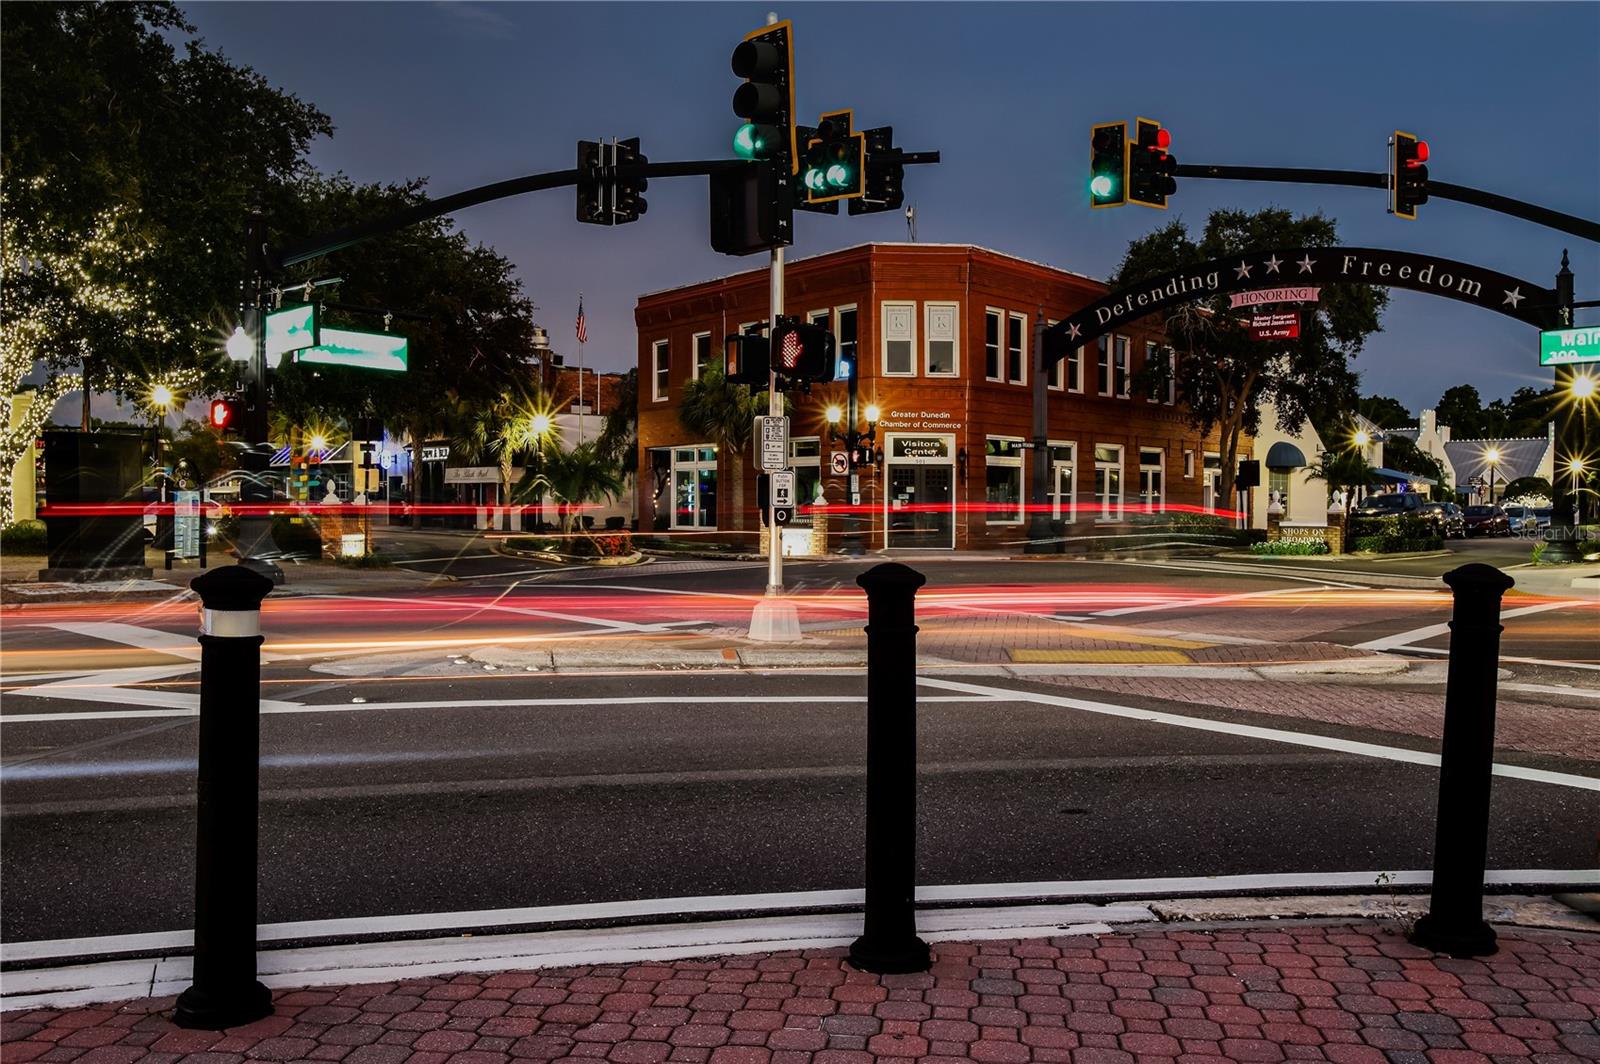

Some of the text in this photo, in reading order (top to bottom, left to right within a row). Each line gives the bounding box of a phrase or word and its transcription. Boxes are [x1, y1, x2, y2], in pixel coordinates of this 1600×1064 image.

[1094, 255, 1482, 326] Defending Freedom
[1241, 289, 1307, 304] HONORING
[1273, 329, 1291, 337] Army
[891, 410, 951, 419] Greater Dunedin
[879, 420, 911, 428] Chamber
[922, 421, 962, 429] Commerce
[901, 440, 940, 448] Visitors
[904, 448, 938, 456] Center
[1282, 527, 1326, 536] SHOPS ON
